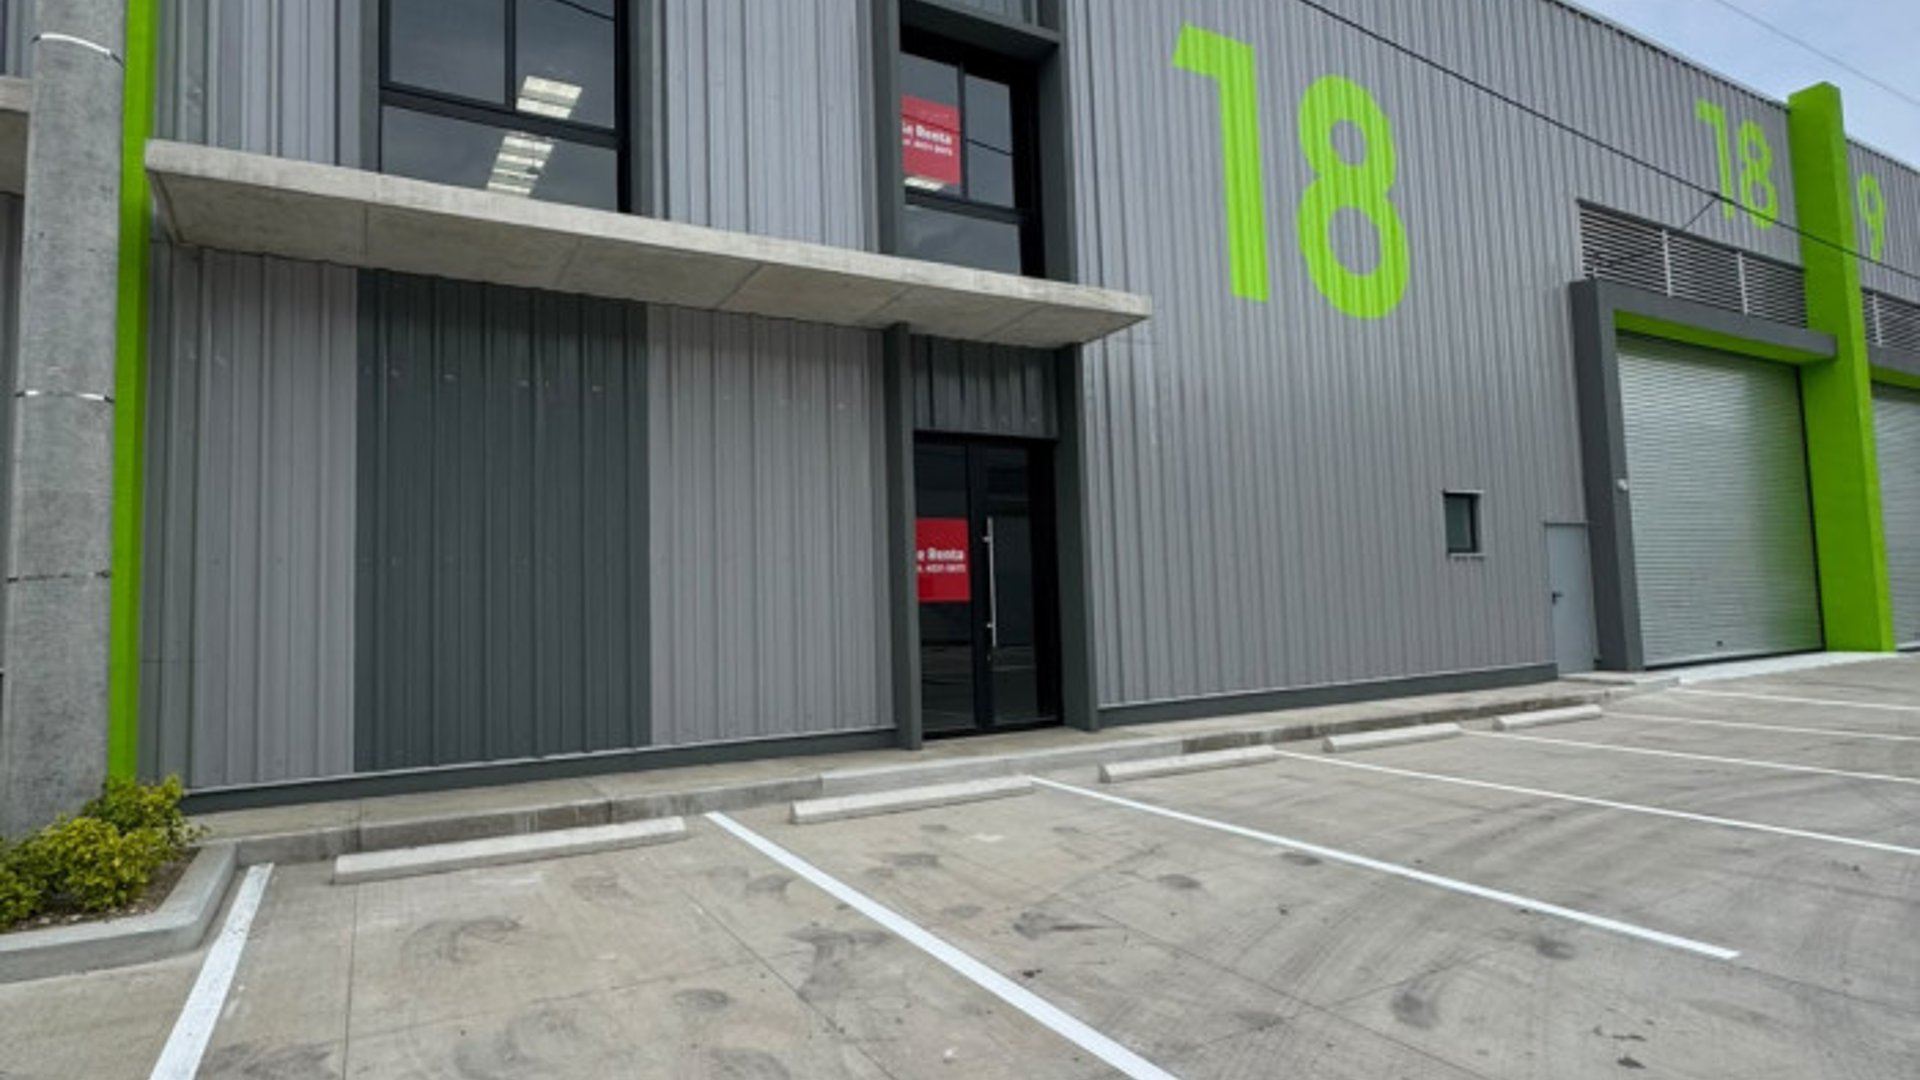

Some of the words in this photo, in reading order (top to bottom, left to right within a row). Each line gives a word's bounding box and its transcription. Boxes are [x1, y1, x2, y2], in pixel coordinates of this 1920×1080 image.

[1172, 21, 1410, 320] 18
[1695, 98, 1779, 230] 18
[927, 547, 965, 561] Renta
